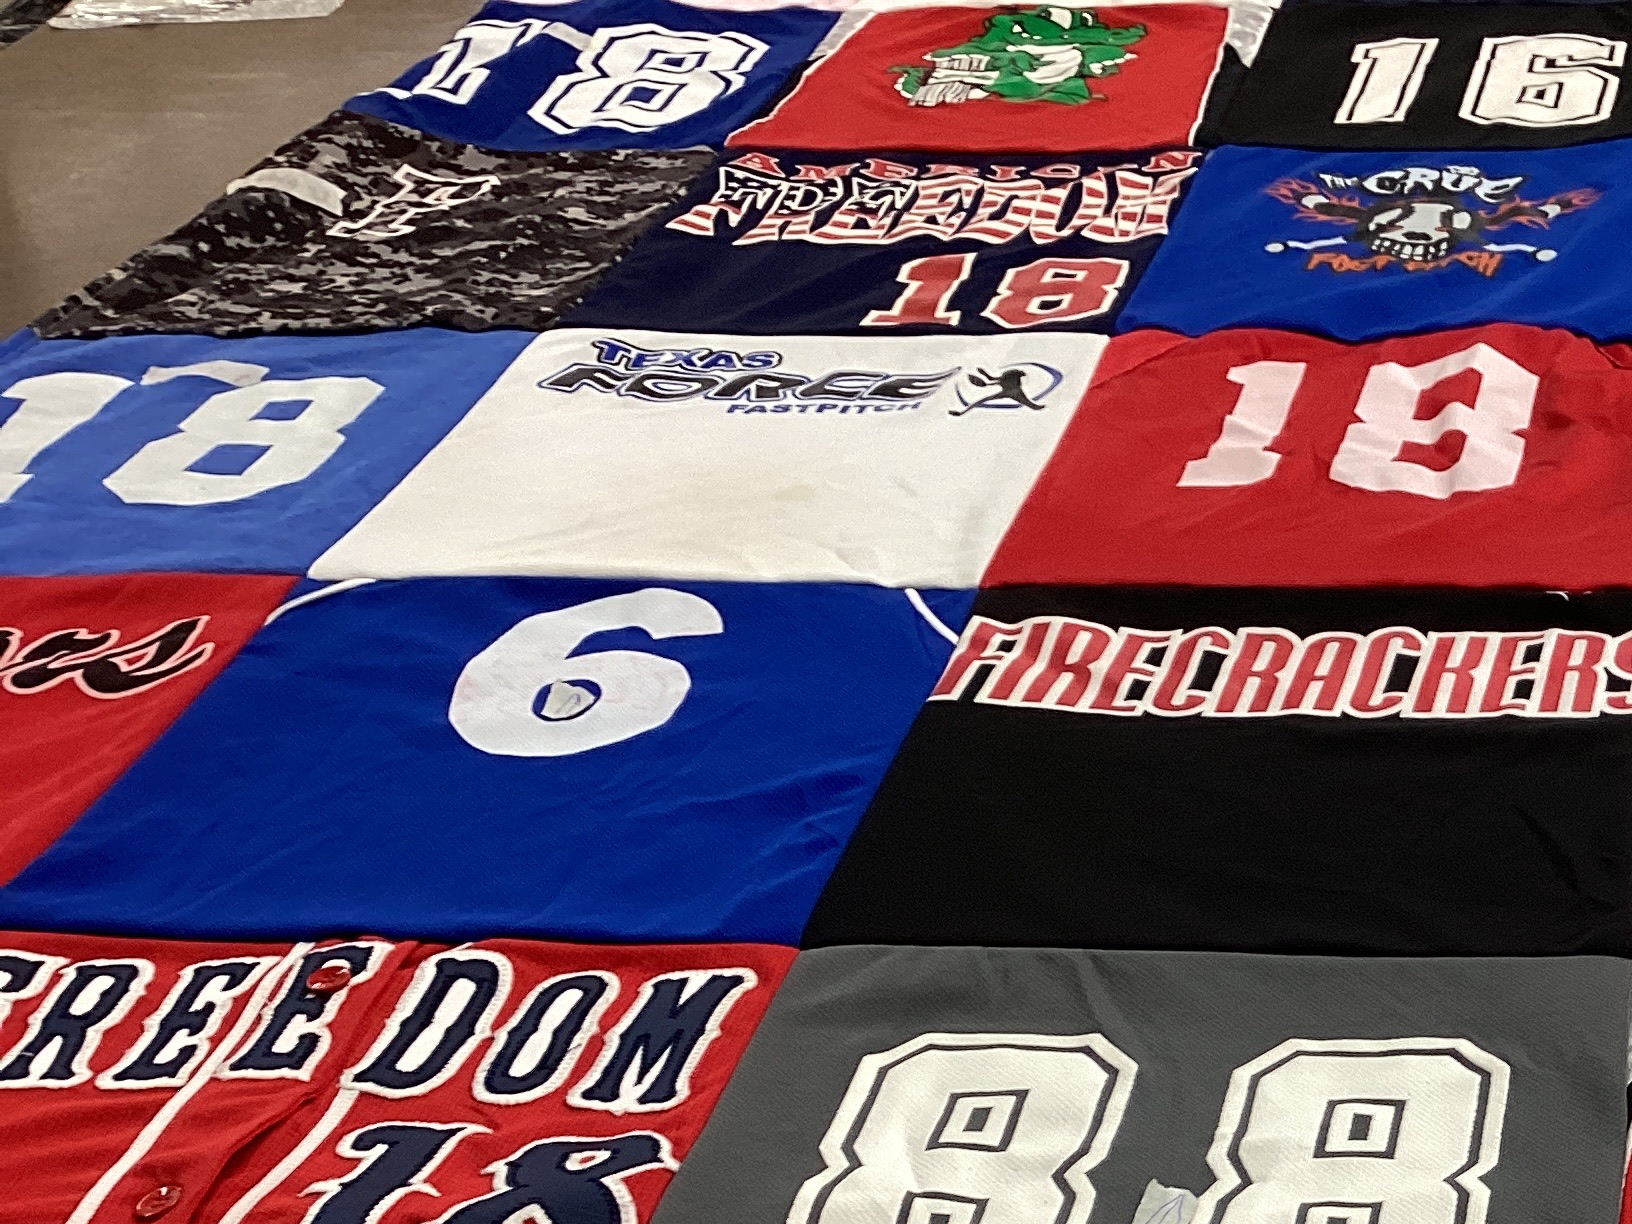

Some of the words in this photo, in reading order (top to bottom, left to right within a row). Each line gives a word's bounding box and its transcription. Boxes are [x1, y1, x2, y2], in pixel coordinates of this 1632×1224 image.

[1333, 33, 1628, 128] 16
[860, 252, 1131, 330] 18
[536, 362, 962, 402] FORCE
[590, 337, 783, 371] TEXAS
[0, 371, 386, 507] 18
[1176, 342, 1540, 500] 18
[448, 587, 725, 757] 6
